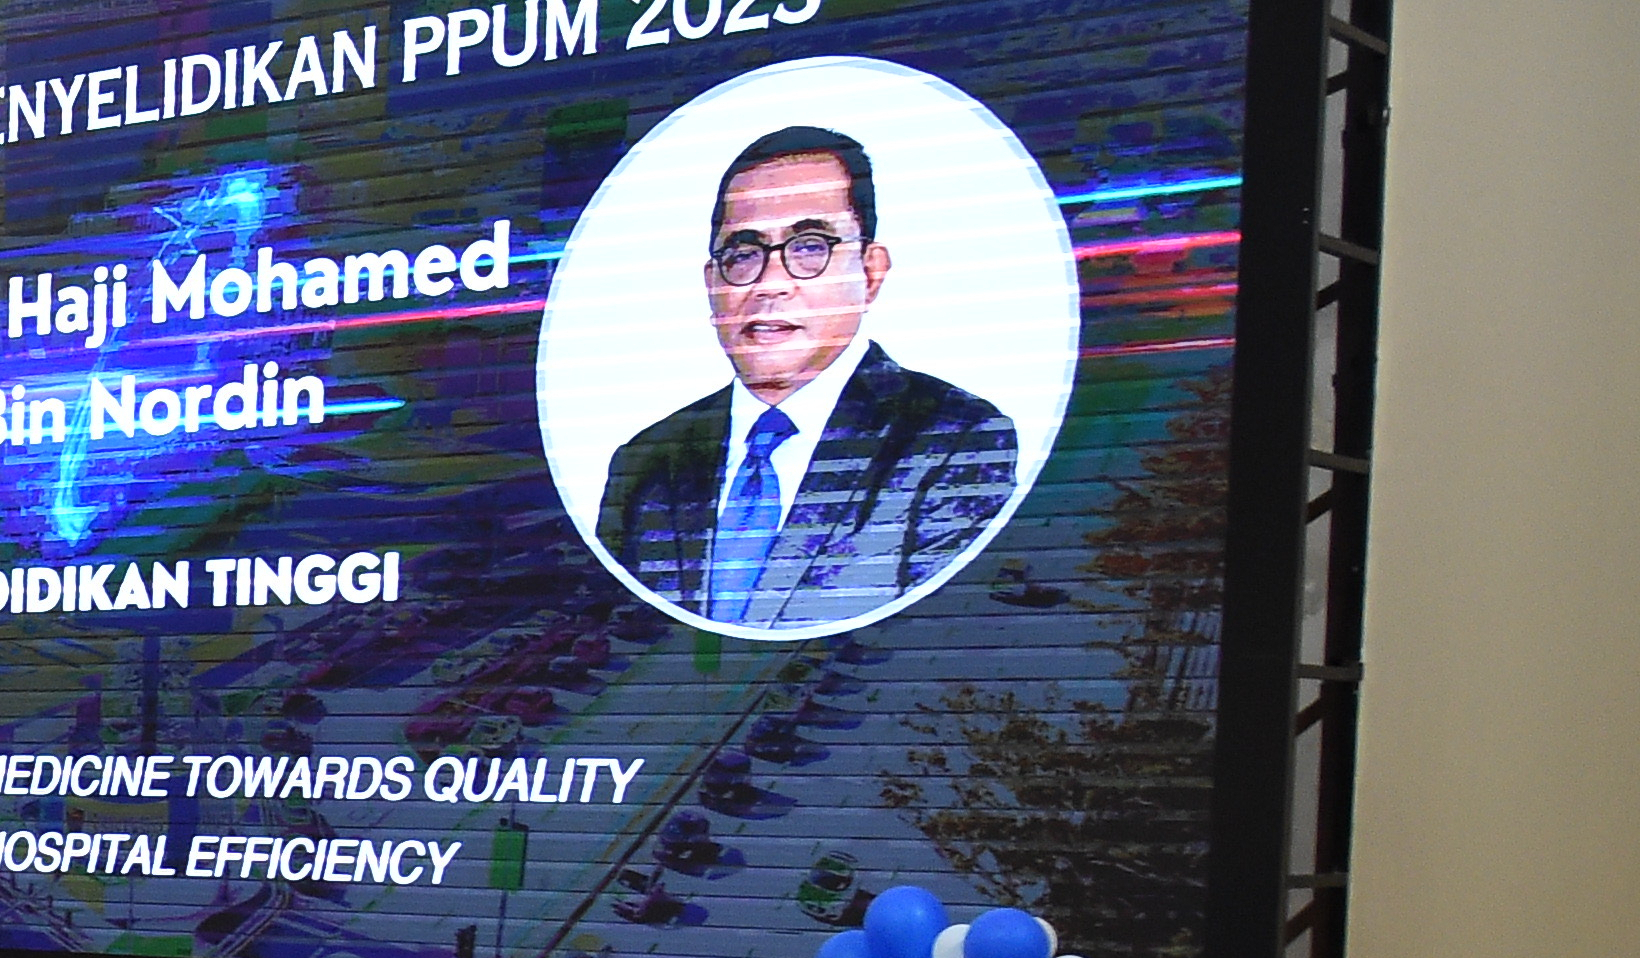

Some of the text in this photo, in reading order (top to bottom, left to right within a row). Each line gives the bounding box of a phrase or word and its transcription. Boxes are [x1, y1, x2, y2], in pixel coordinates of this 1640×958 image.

[402, 0, 598, 83] PPUM
[7, 263, 127, 338] Haji
[151, 219, 511, 324] Mohamed
[89, 360, 326, 440] Nordin
[205, 551, 400, 607] TINGGI
[182, 755, 415, 801] TOWARDS
[424, 756, 645, 804] QUALITY
[185, 835, 462, 885] EFFICIENCY
